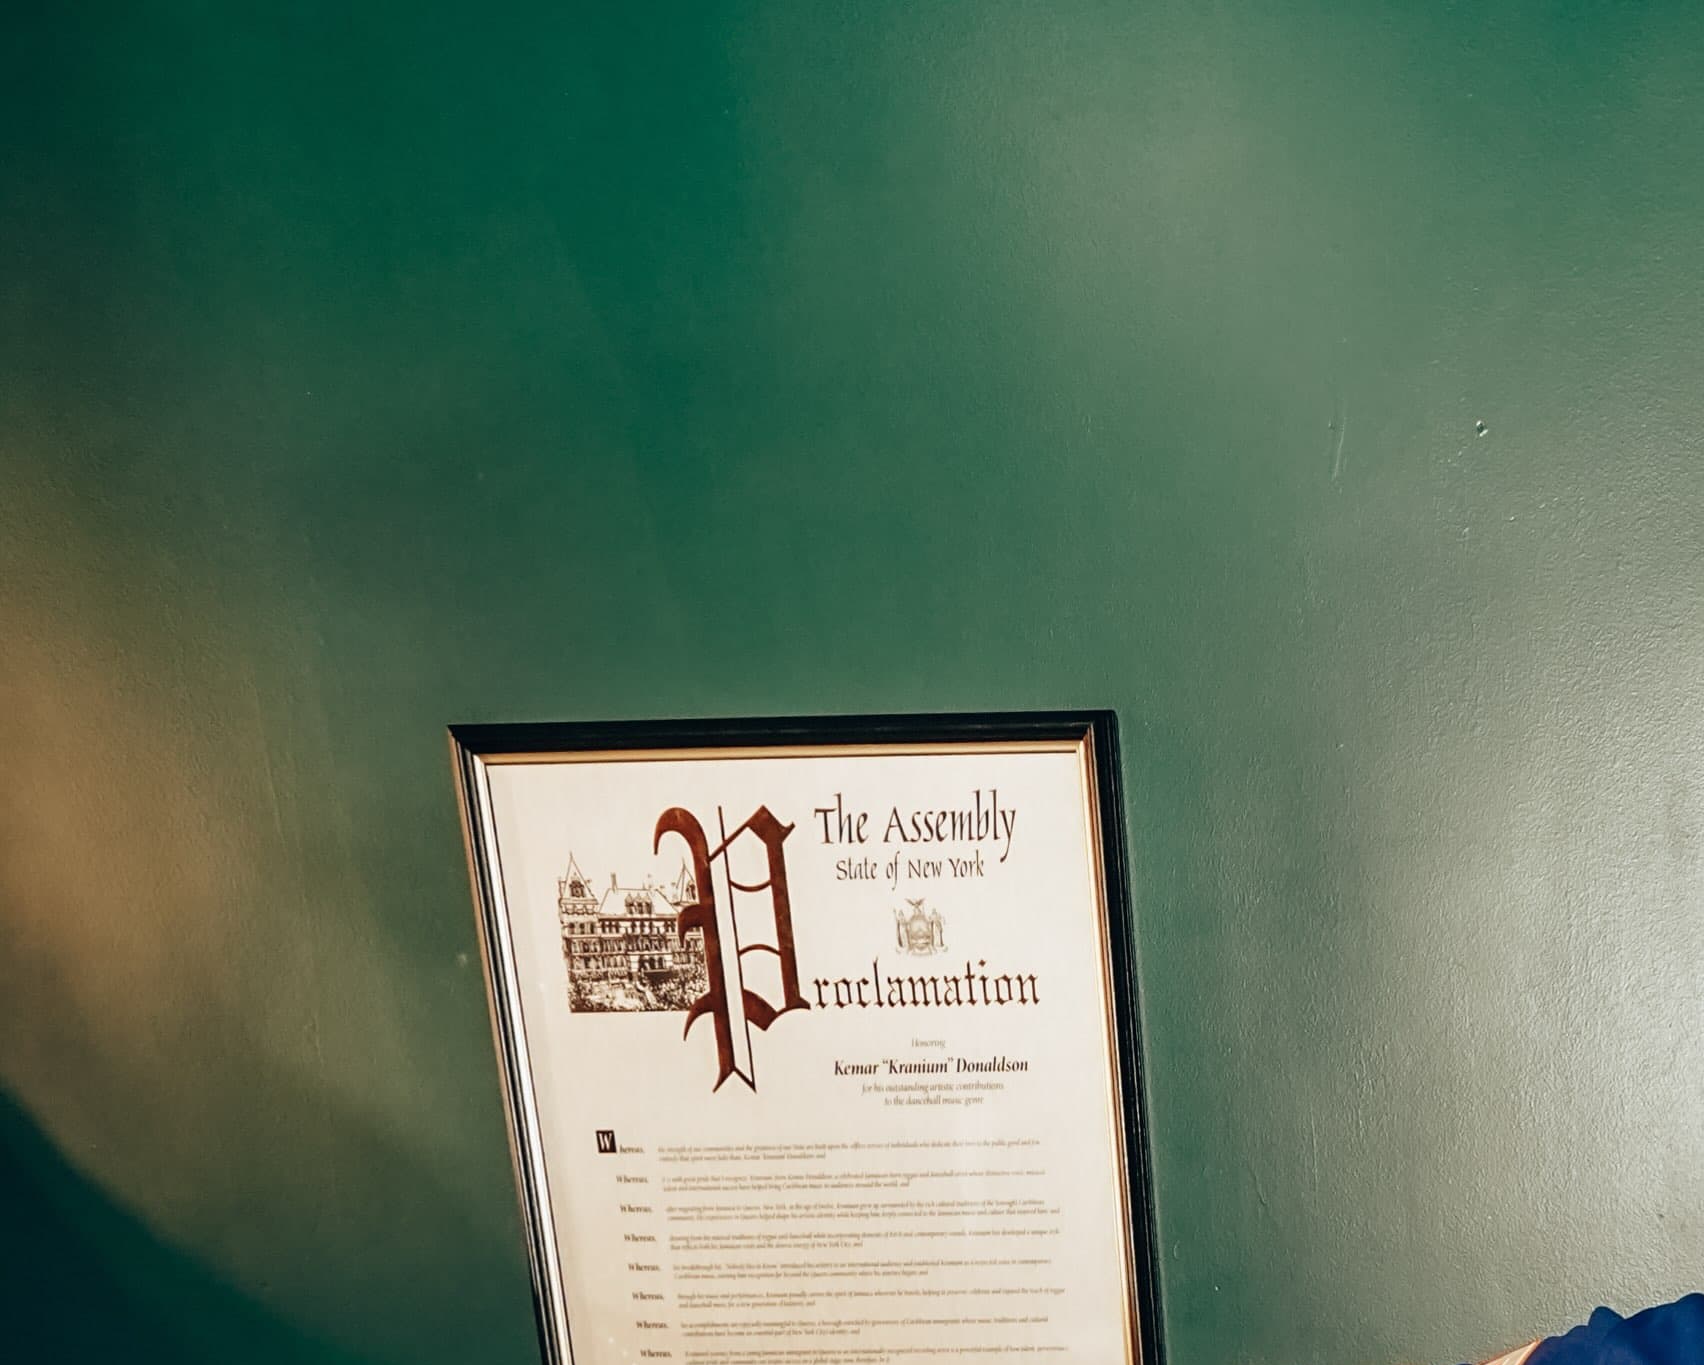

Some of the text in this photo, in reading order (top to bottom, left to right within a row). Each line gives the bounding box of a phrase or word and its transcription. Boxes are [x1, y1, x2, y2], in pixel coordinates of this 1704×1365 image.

[814, 790, 1017, 863] The Assembly
[836, 850, 984, 890] State of New York
[911, 1037, 946, 1049] Honoring
[834, 1060, 880, 1076] Kemar
[956, 1056, 1029, 1073] Donaldson
[885, 1082, 929, 1094] outstanding
